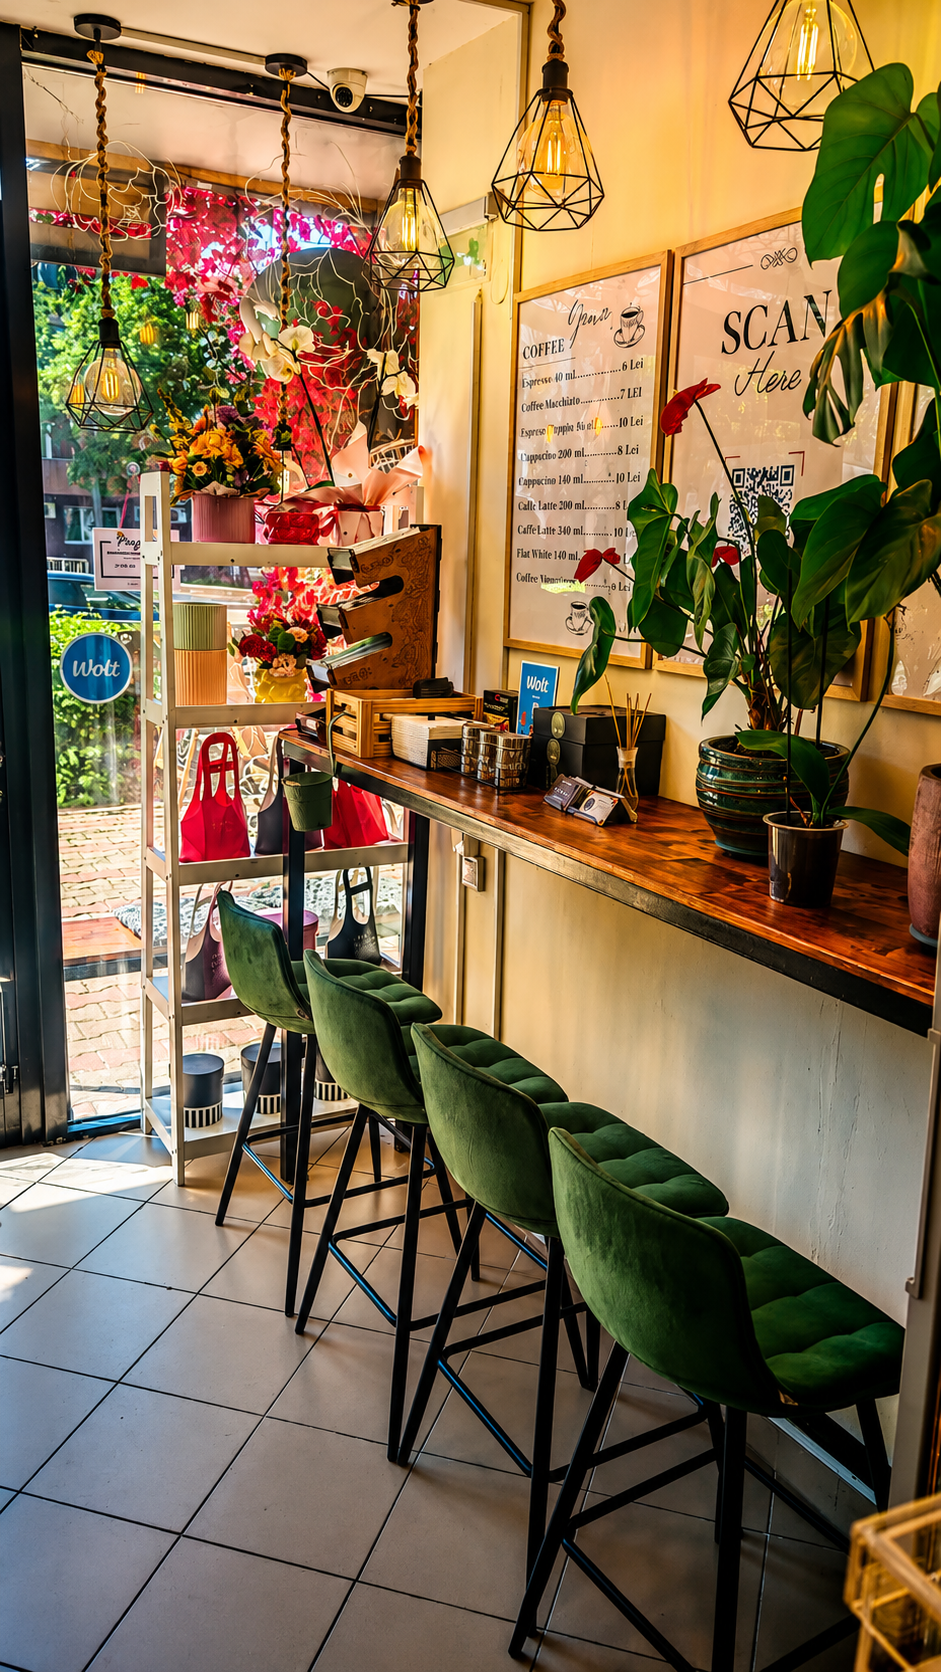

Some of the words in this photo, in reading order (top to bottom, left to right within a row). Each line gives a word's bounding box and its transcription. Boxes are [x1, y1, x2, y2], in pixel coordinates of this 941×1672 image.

[721, 289, 832, 355] SCAN
[522, 338, 565, 360] COFFEE
[522, 373, 552, 389] Espresso
[554, 371, 563, 383] 40
[630, 358, 644, 371] Lei
[734, 350, 802, 397] Here
[521, 401, 545, 413] Coffee
[545, 397, 581, 409] Macchiato
[627, 387, 642, 399] LEI
[619, 417, 628, 428] 10
[630, 415, 644, 427] Lei
[558, 448, 572, 460] 200
[625, 444, 639, 455] Lei
[558, 474, 571, 485] 140
[627, 471, 641, 483] Lei
[558, 500, 572, 511] 200
[517, 524, 537, 535] Caffe
[557, 525, 571, 536] 340
[516, 548, 530, 559] Flat
[531, 549, 553, 560] White
[554, 549, 566, 561] 140
[516, 572, 539, 584] Coffee
[618, 581, 631, 592] Lei
[72, 658, 121, 677] Wolt
[526, 675, 550, 693] Wolt
